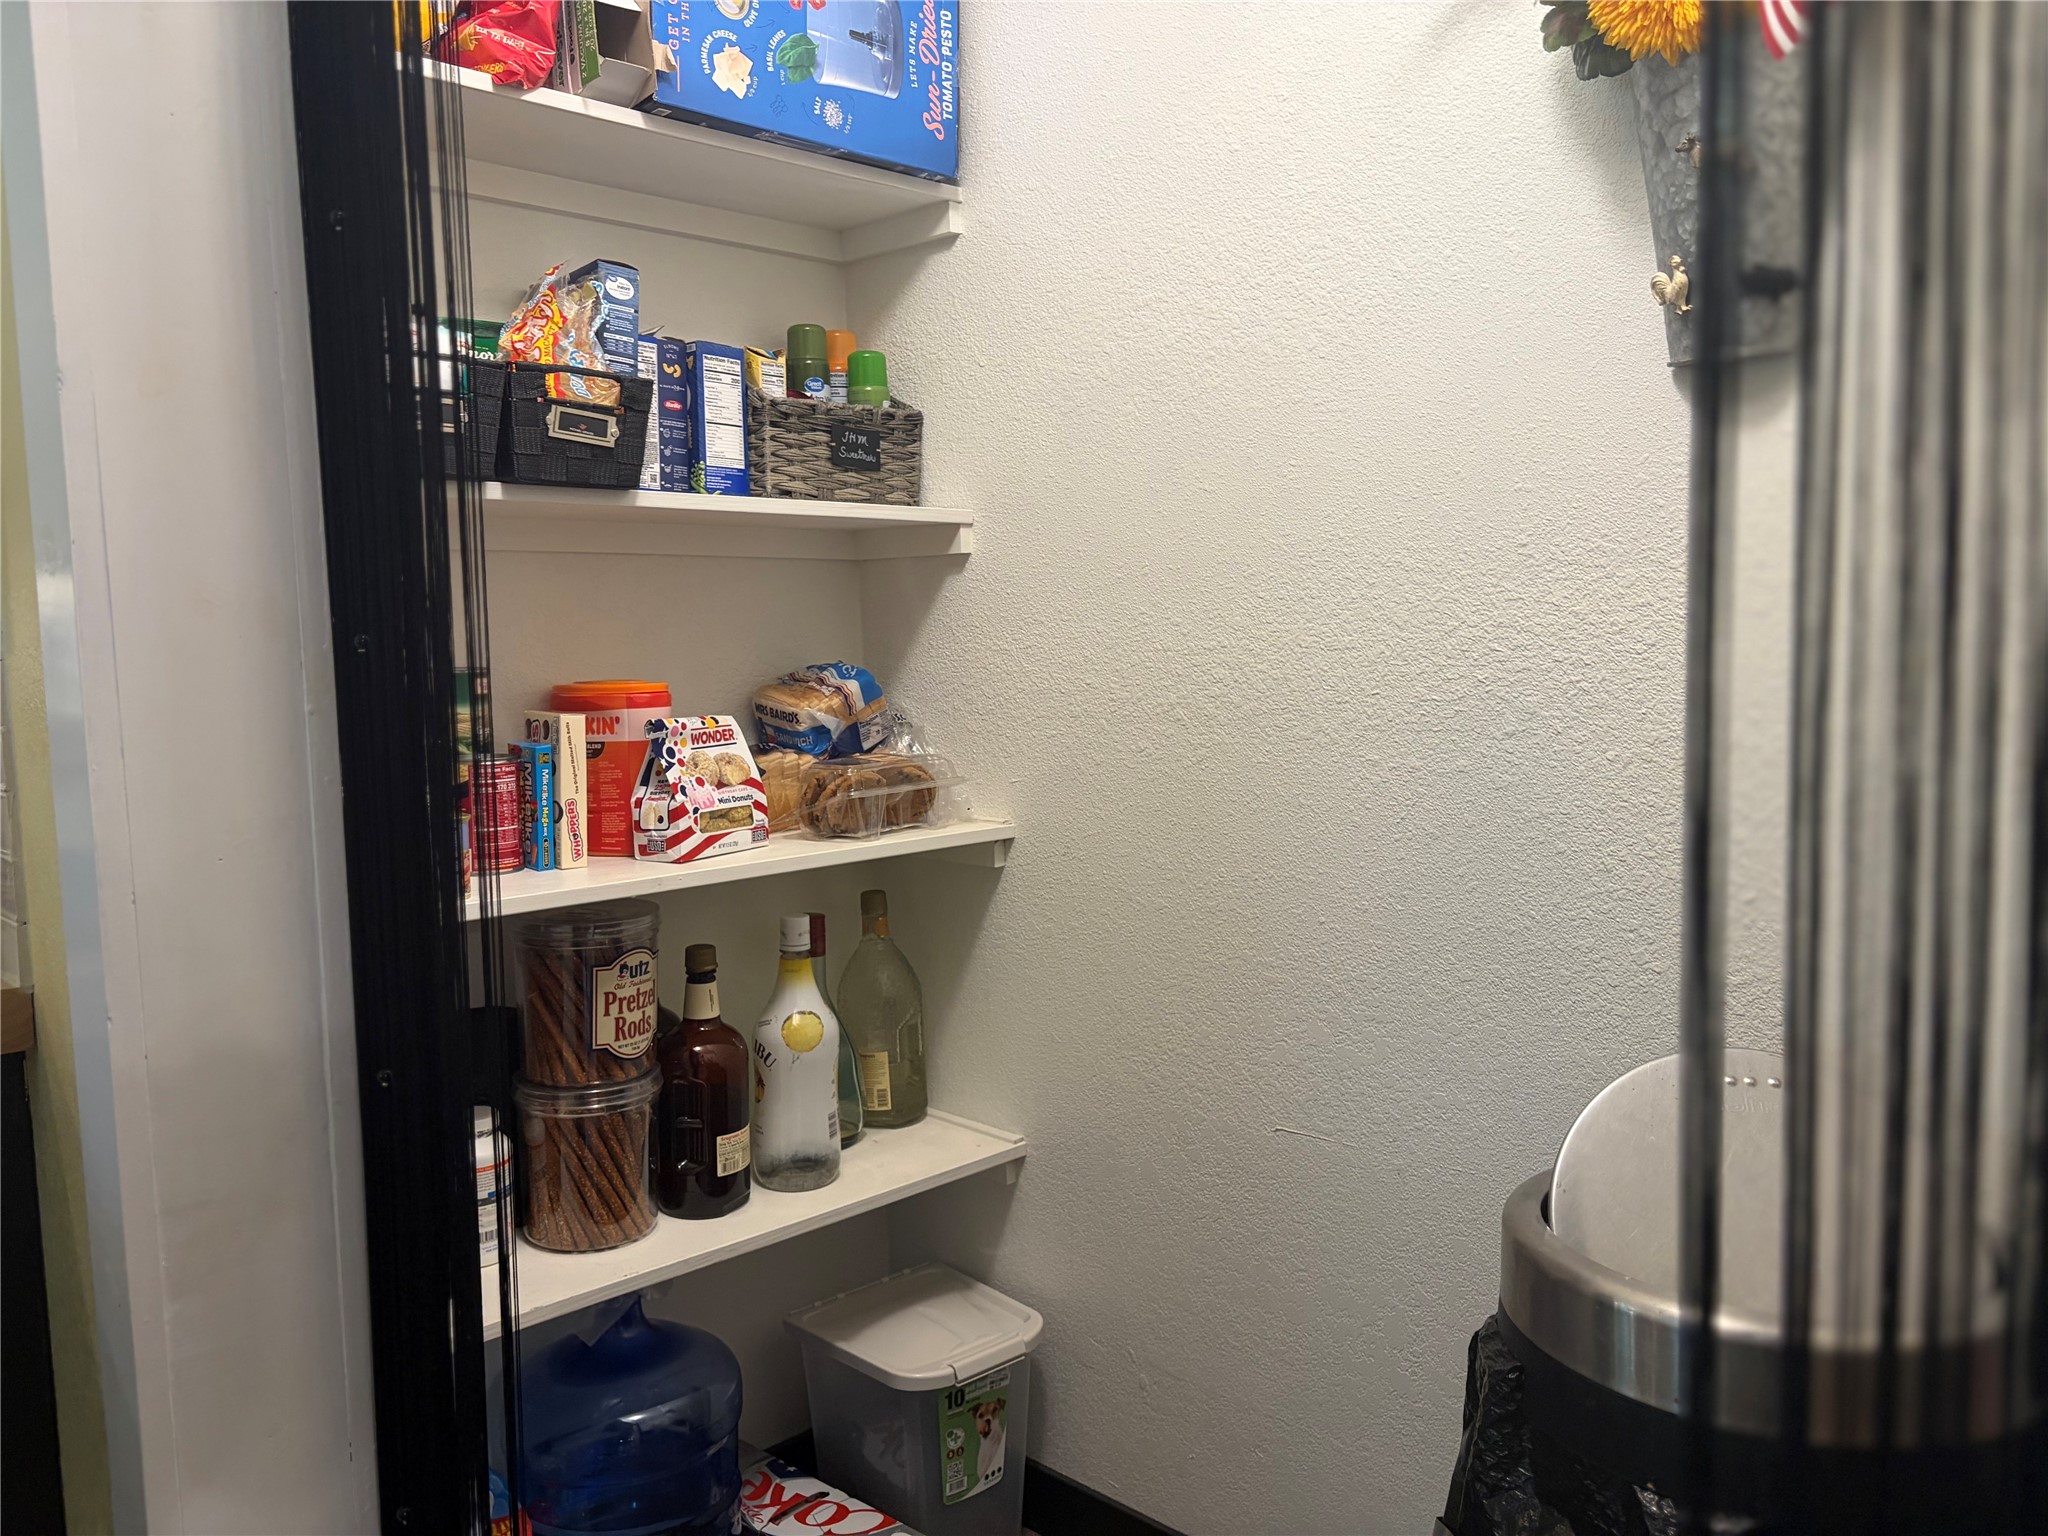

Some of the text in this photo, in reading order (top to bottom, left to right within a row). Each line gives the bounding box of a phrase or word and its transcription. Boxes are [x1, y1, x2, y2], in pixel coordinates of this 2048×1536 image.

[575, 0, 583, 22] SEA
[743, 9, 758, 28] OLIVE
[667, 13, 680, 51] GET
[681, 2, 691, 43] IN TH
[577, 23, 587, 70] VACUUM
[908, 20, 919, 57] MAKE
[700, 29, 739, 75] PARMESAN CHEESE
[765, 29, 787, 73] BASIL LEAVES
[940, 9, 954, 121] TOMATO PESTO
[813, 96, 823, 116] SALT
[703, 355, 741, 366] Nutrition Facts
[704, 374, 723, 382] Calories
[807, 380, 823, 388] Great
[754, 702, 801, 725] MRS BAIRD'S
[586, 715, 621, 736] KIN'
[690, 728, 736, 746] WONDER
[541, 768, 549, 790] Mike
[571, 765, 579, 785] Original
[524, 762, 534, 816] Mike
[717, 787, 738, 795] BIRTHDAY
[717, 793, 754, 805] Mini Donuts
[541, 806, 549, 828] Mega
[566, 799, 583, 860] WHOPPERS
[629, 960, 651, 979] utz
[603, 978, 656, 1017] Pretzel
[613, 982, 626, 991] Old
[614, 1009, 652, 1042] Rods
[944, 1388, 966, 1411] 10
